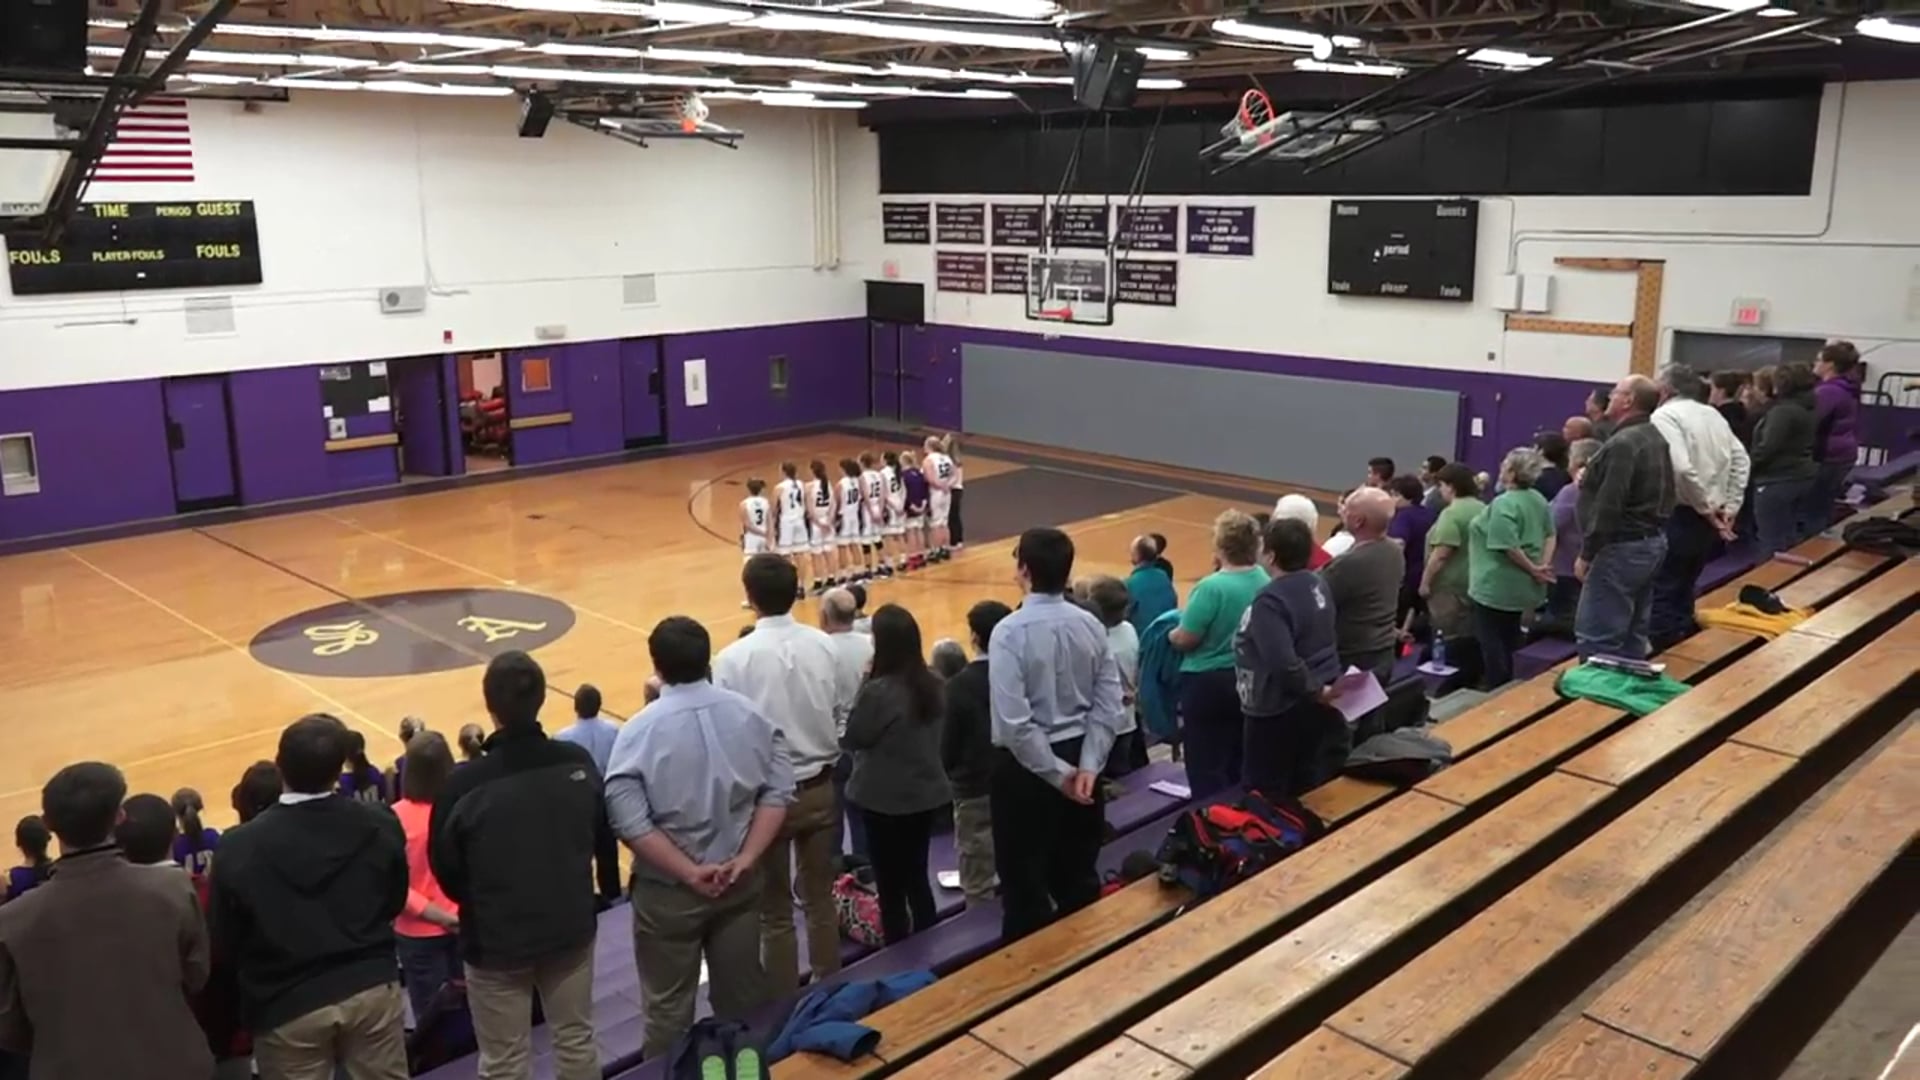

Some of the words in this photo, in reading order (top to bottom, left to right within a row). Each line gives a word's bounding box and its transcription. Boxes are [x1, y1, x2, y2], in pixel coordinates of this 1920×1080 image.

[92, 203, 129, 218] TIME
[155, 205, 192, 217] PERIOD
[196, 202, 241, 216] GUEST
[196, 244, 241, 259] FOULS
[1383, 244, 1410, 257] period
[847, 487, 859, 506] 10
[755, 508, 763, 526] 3
